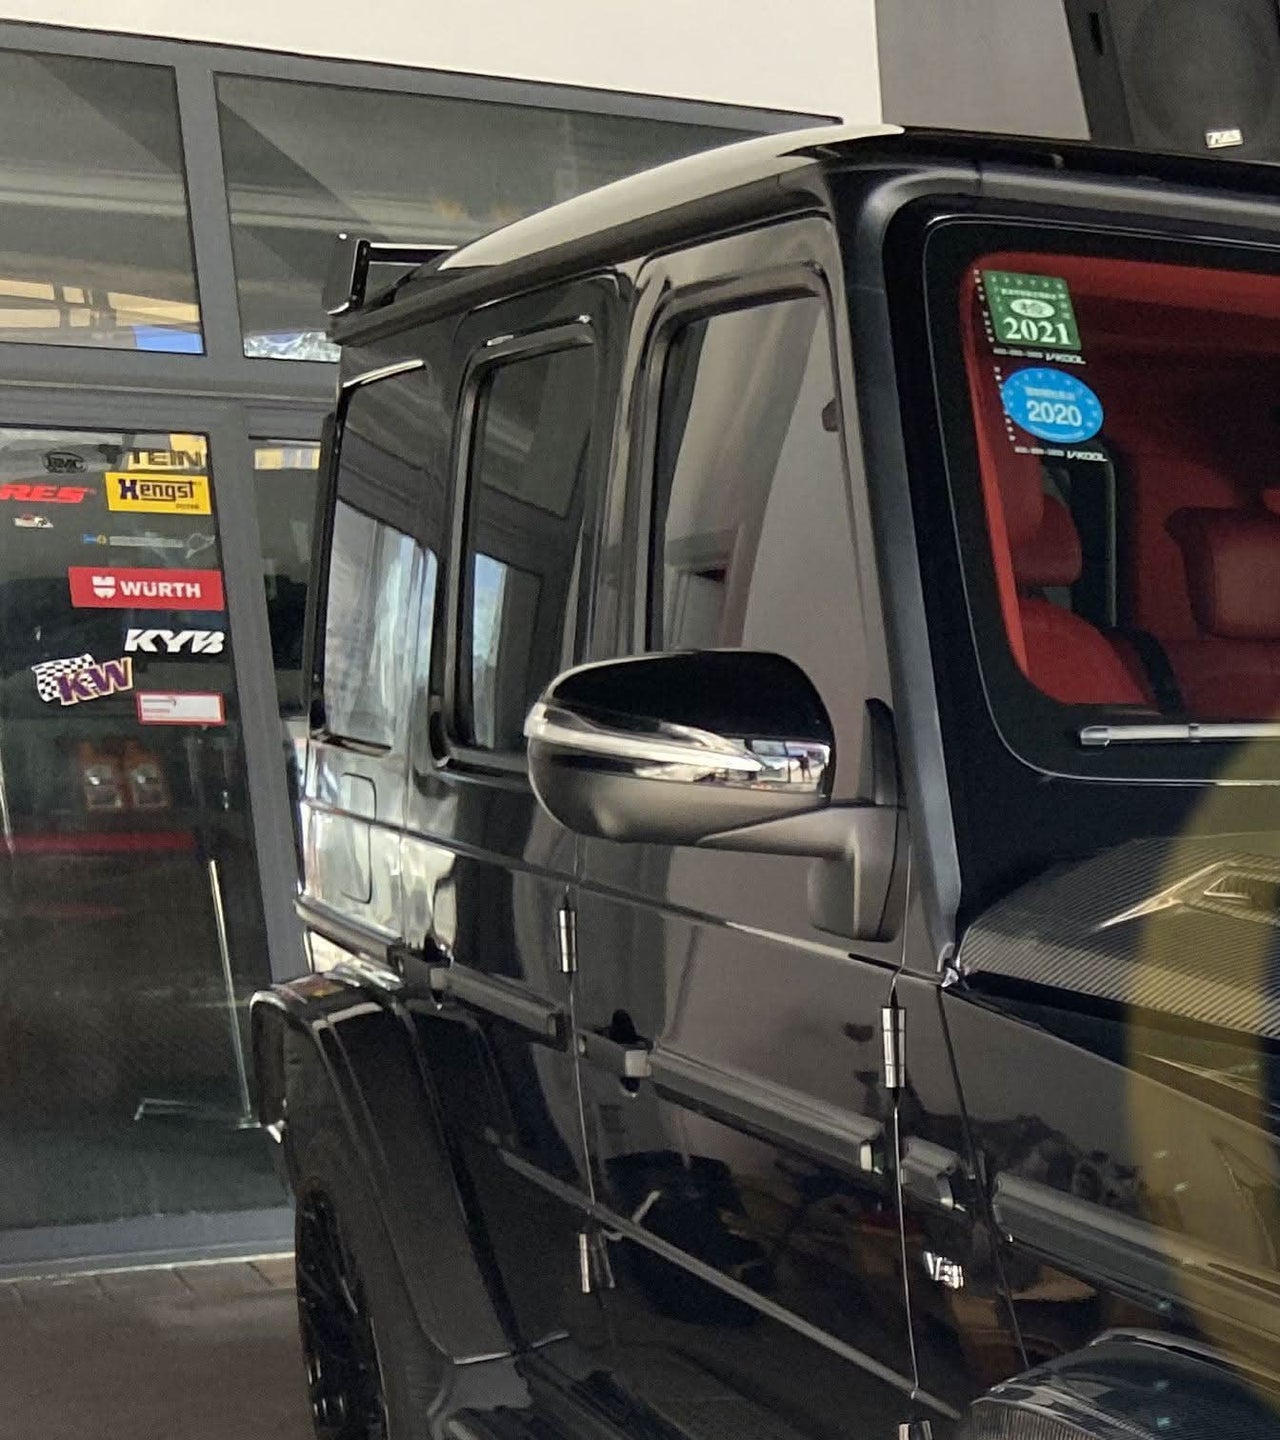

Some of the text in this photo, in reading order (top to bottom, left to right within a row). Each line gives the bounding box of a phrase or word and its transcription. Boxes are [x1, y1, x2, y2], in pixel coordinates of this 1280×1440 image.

[1003, 317, 1073, 345] 2021
[1026, 400, 1082, 427] 2020
[128, 449, 203, 467] TEIN
[118, 478, 194, 502] Hengst
[120, 580, 202, 598] WÜRTH
[124, 629, 225, 654] KYB
[54, 656, 134, 706] KW
